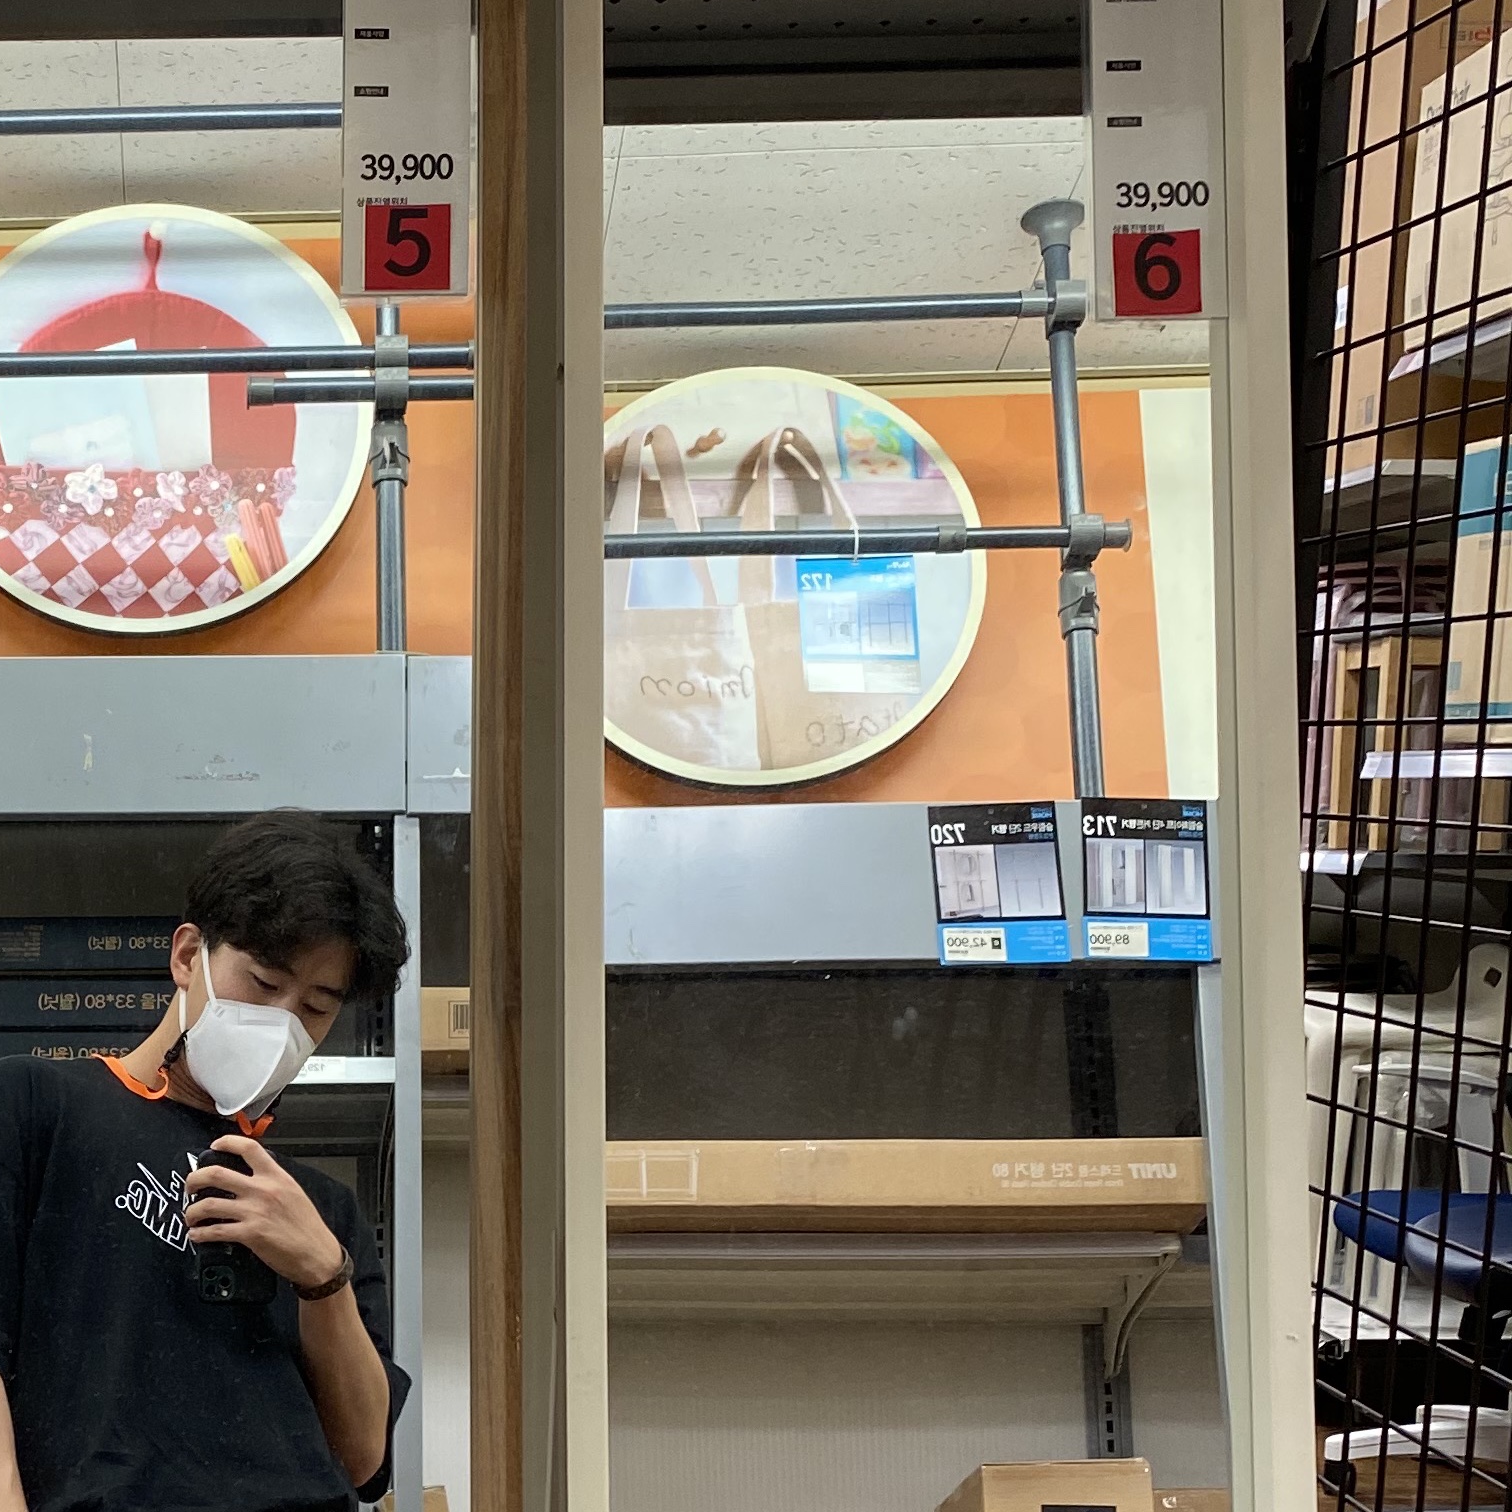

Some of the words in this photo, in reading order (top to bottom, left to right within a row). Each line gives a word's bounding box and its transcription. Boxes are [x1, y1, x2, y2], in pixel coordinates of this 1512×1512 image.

[360, 153, 454, 186] 39,900
[1116, 180, 1210, 212] 39,900
[384, 207, 432, 277] 5
[1134, 233, 1182, 301] 6
